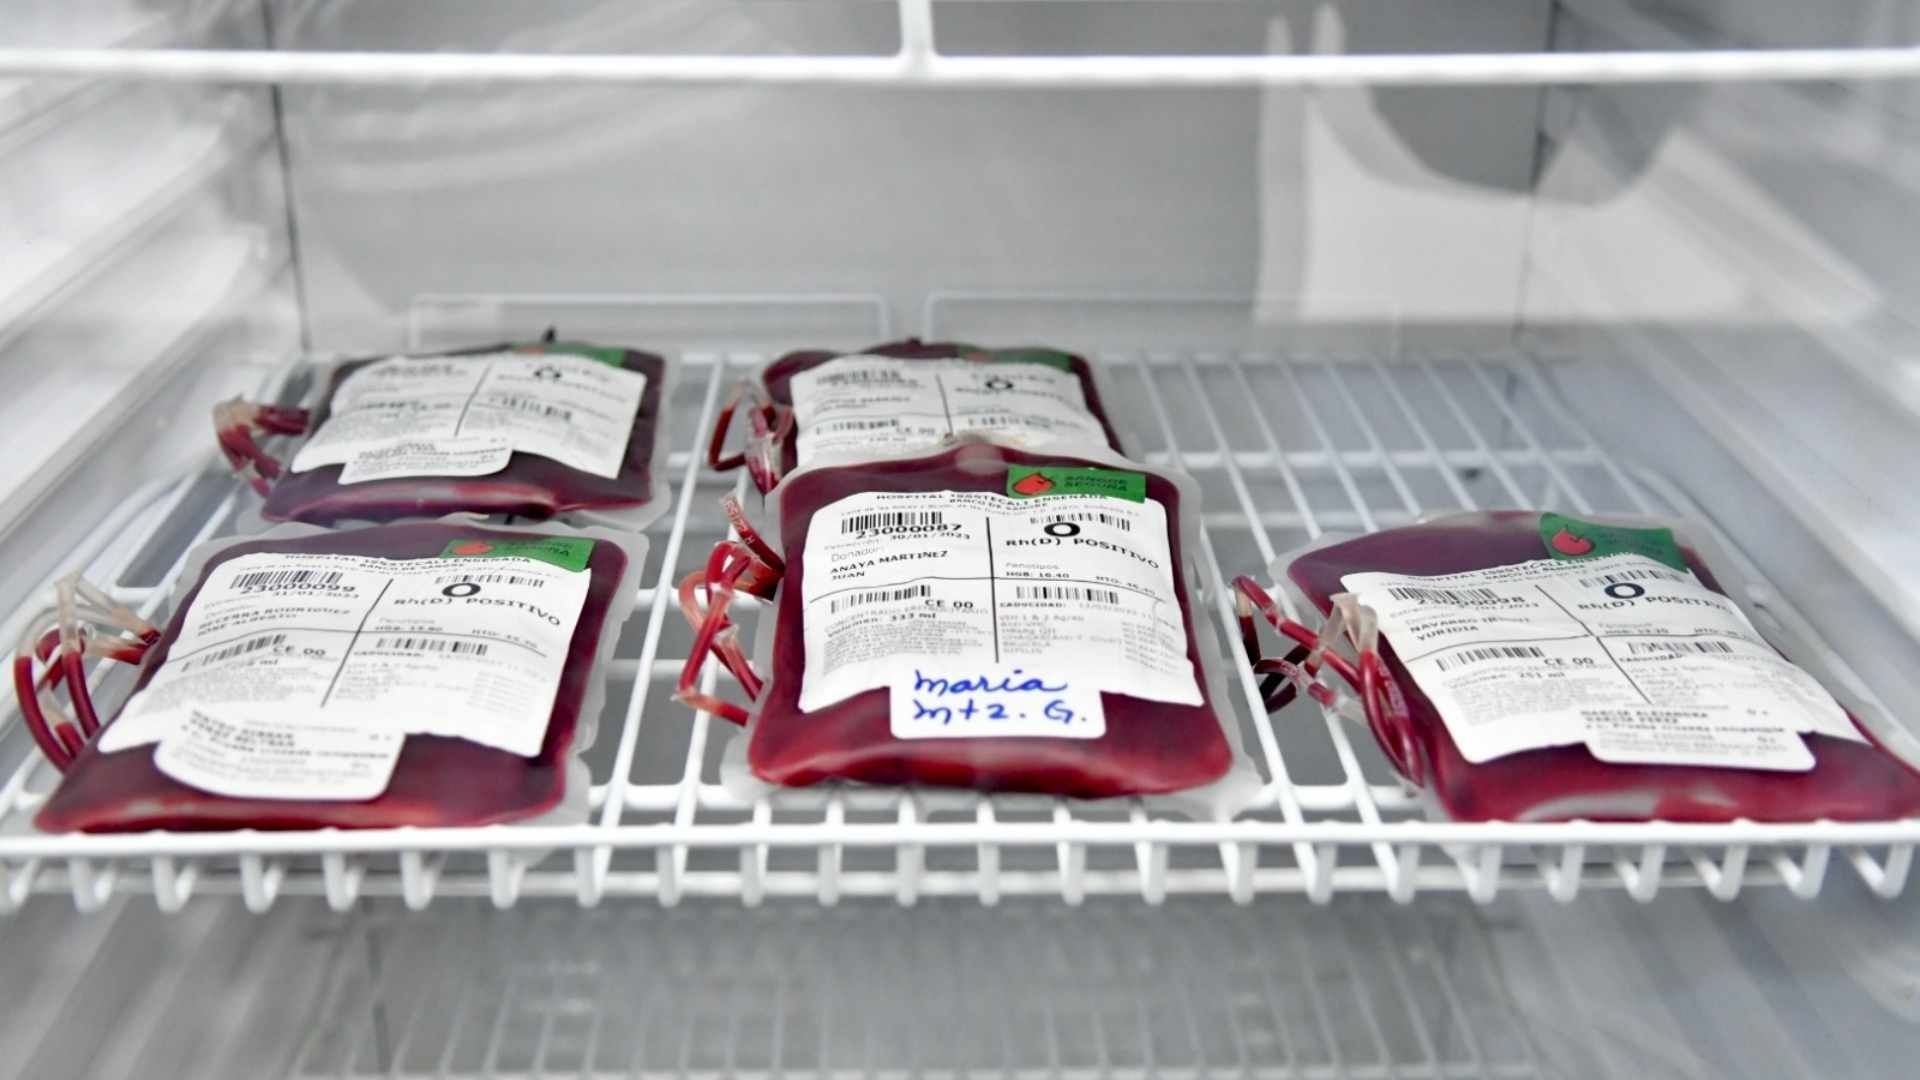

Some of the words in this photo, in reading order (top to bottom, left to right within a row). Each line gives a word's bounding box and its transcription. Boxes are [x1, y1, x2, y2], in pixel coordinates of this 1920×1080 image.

[856, 524, 962, 539] 23000087
[1044, 522, 1081, 537] O
[1006, 538, 1061, 547] Rh(D)
[1073, 538, 1159, 569] POSITIVO
[831, 560, 875, 574] ANAYA
[879, 550, 948, 564] MARTINEZ
[832, 571, 865, 580] JUAN
[240, 583, 356, 595] 23000099
[442, 582, 481, 598] O
[1604, 582, 1645, 599] O
[466, 597, 561, 626] POSITIVO
